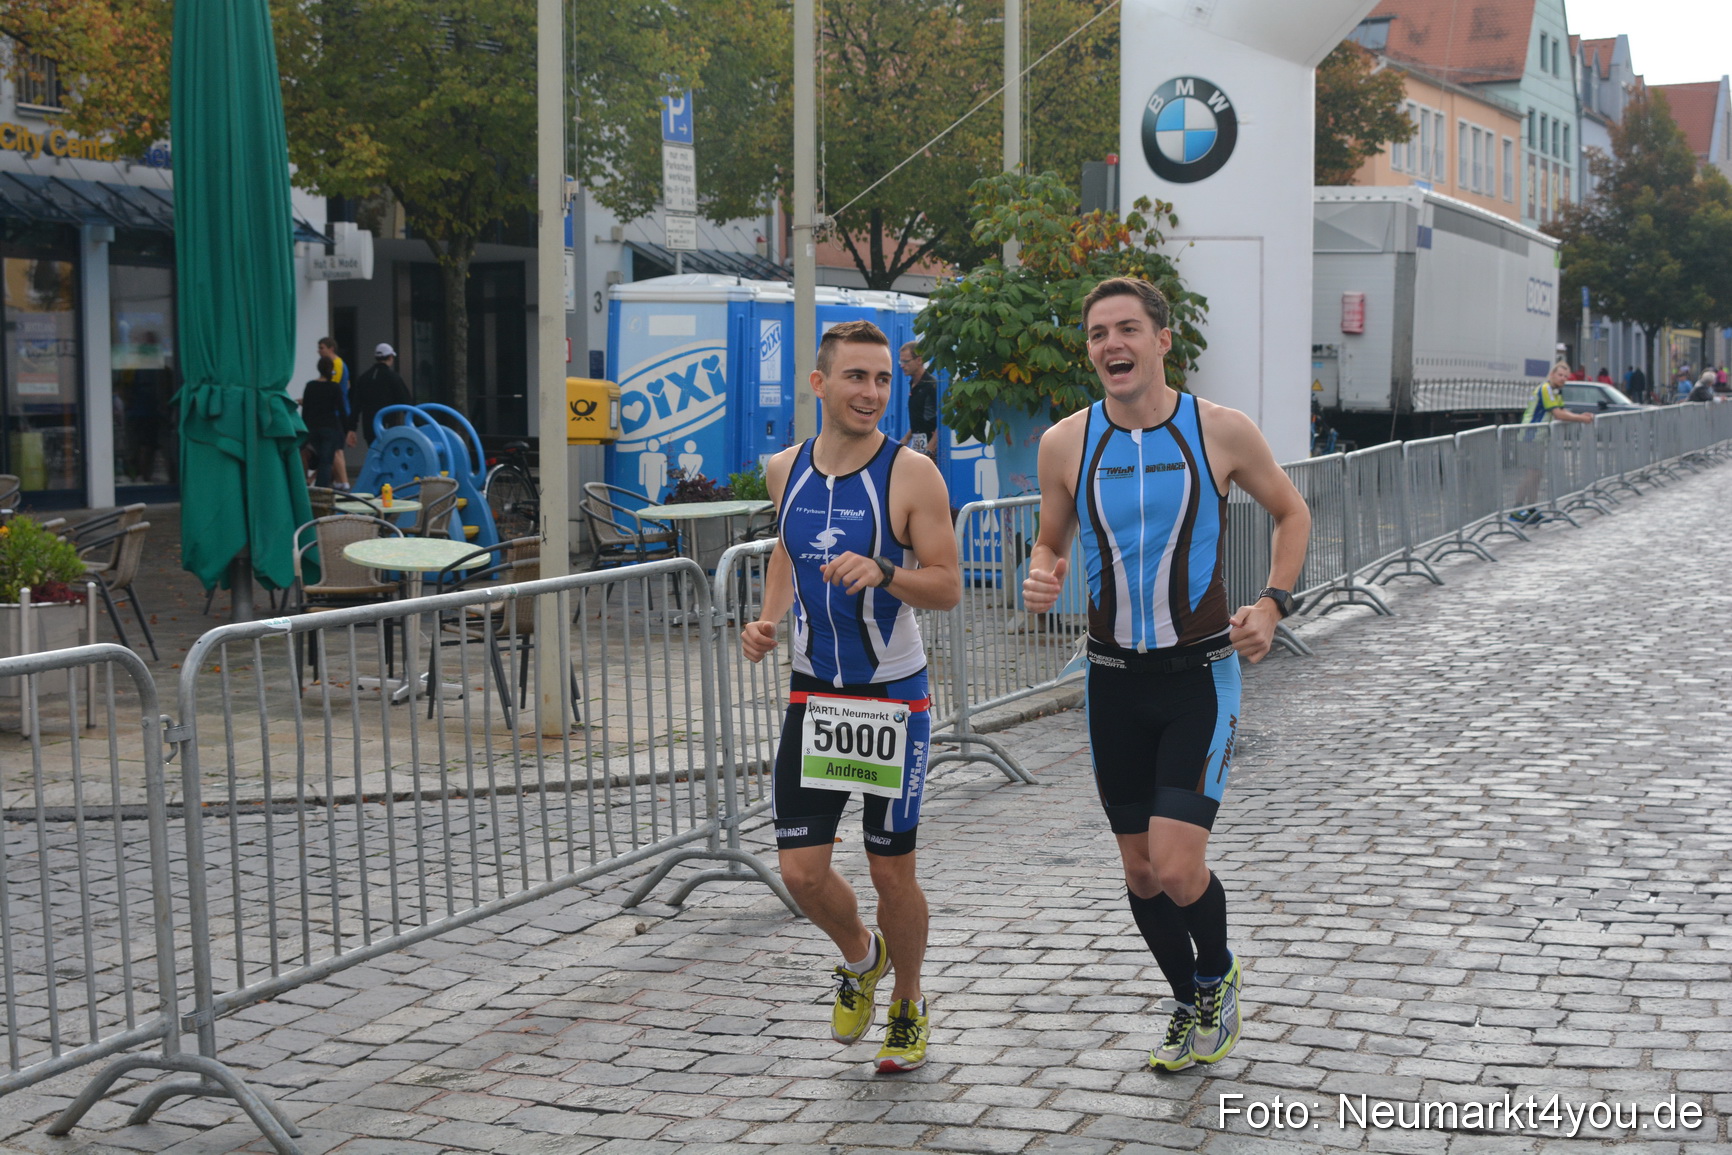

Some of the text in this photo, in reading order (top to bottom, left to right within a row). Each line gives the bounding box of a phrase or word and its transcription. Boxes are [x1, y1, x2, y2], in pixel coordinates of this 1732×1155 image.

[669, 86, 685, 133] P
[1148, 78, 1230, 114] BMW
[0, 122, 44, 159] City
[594, 291, 603, 313] 3
[808, 704, 889, 721] PARTL Neumarkt
[806, 747, 811, 755] S
[814, 719, 896, 760] 5000
[825, 762, 878, 781] Andreas
